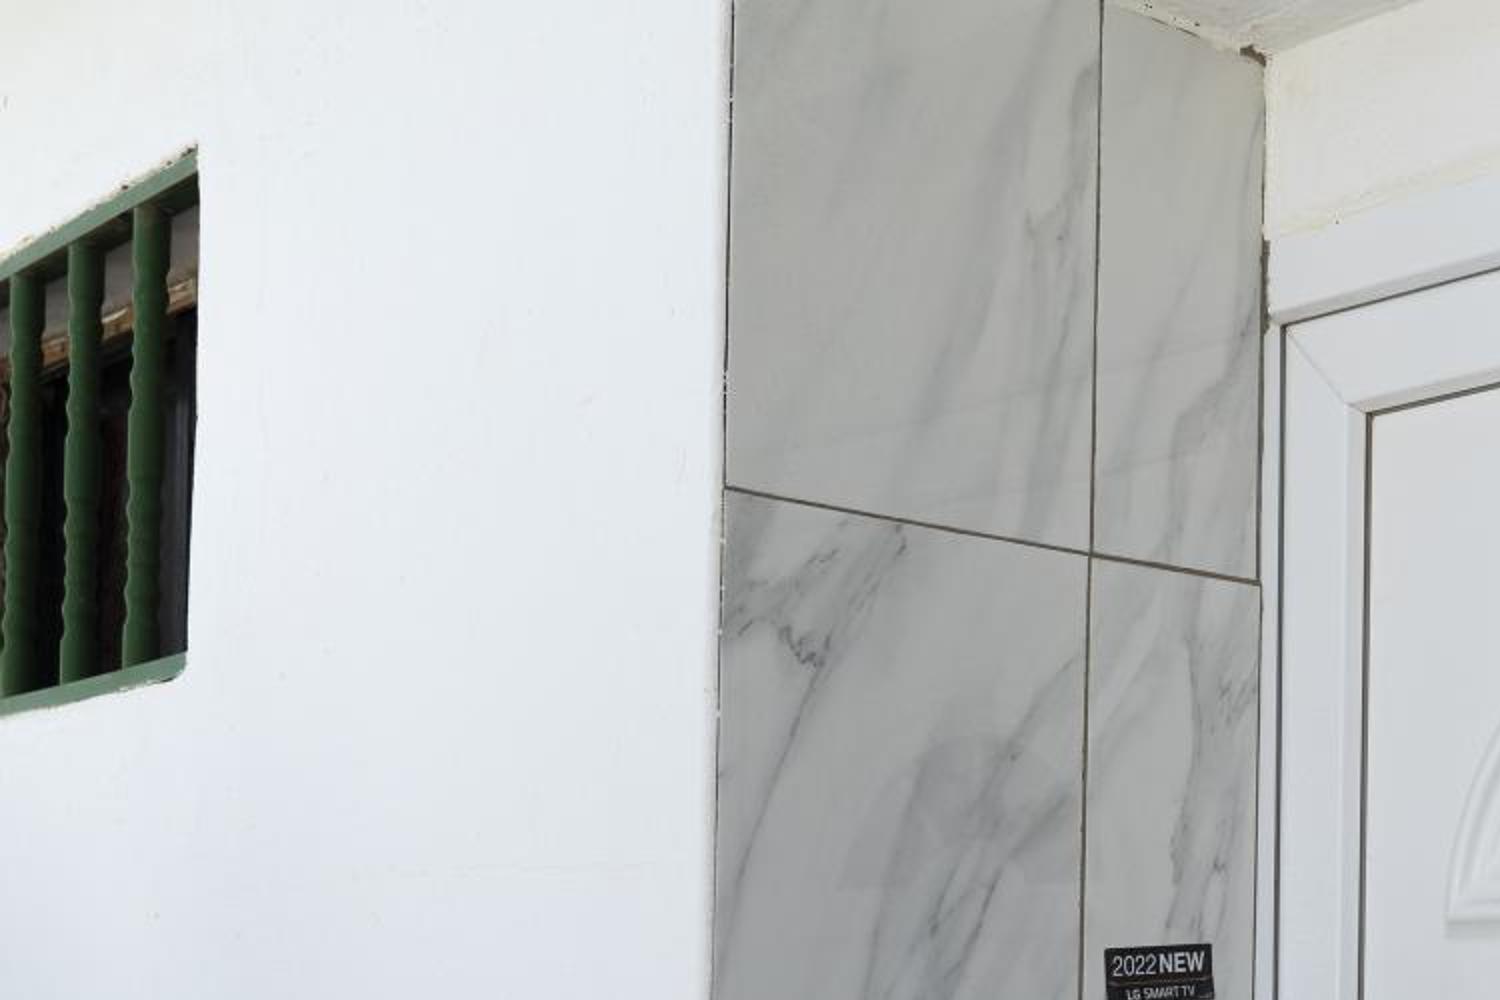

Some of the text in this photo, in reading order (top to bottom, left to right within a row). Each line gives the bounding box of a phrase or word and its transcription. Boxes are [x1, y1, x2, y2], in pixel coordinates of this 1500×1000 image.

[1127, 989, 1141, 1000] LG
[1143, 986, 1180, 1000] SMART
[1182, 985, 1195, 997] TV
